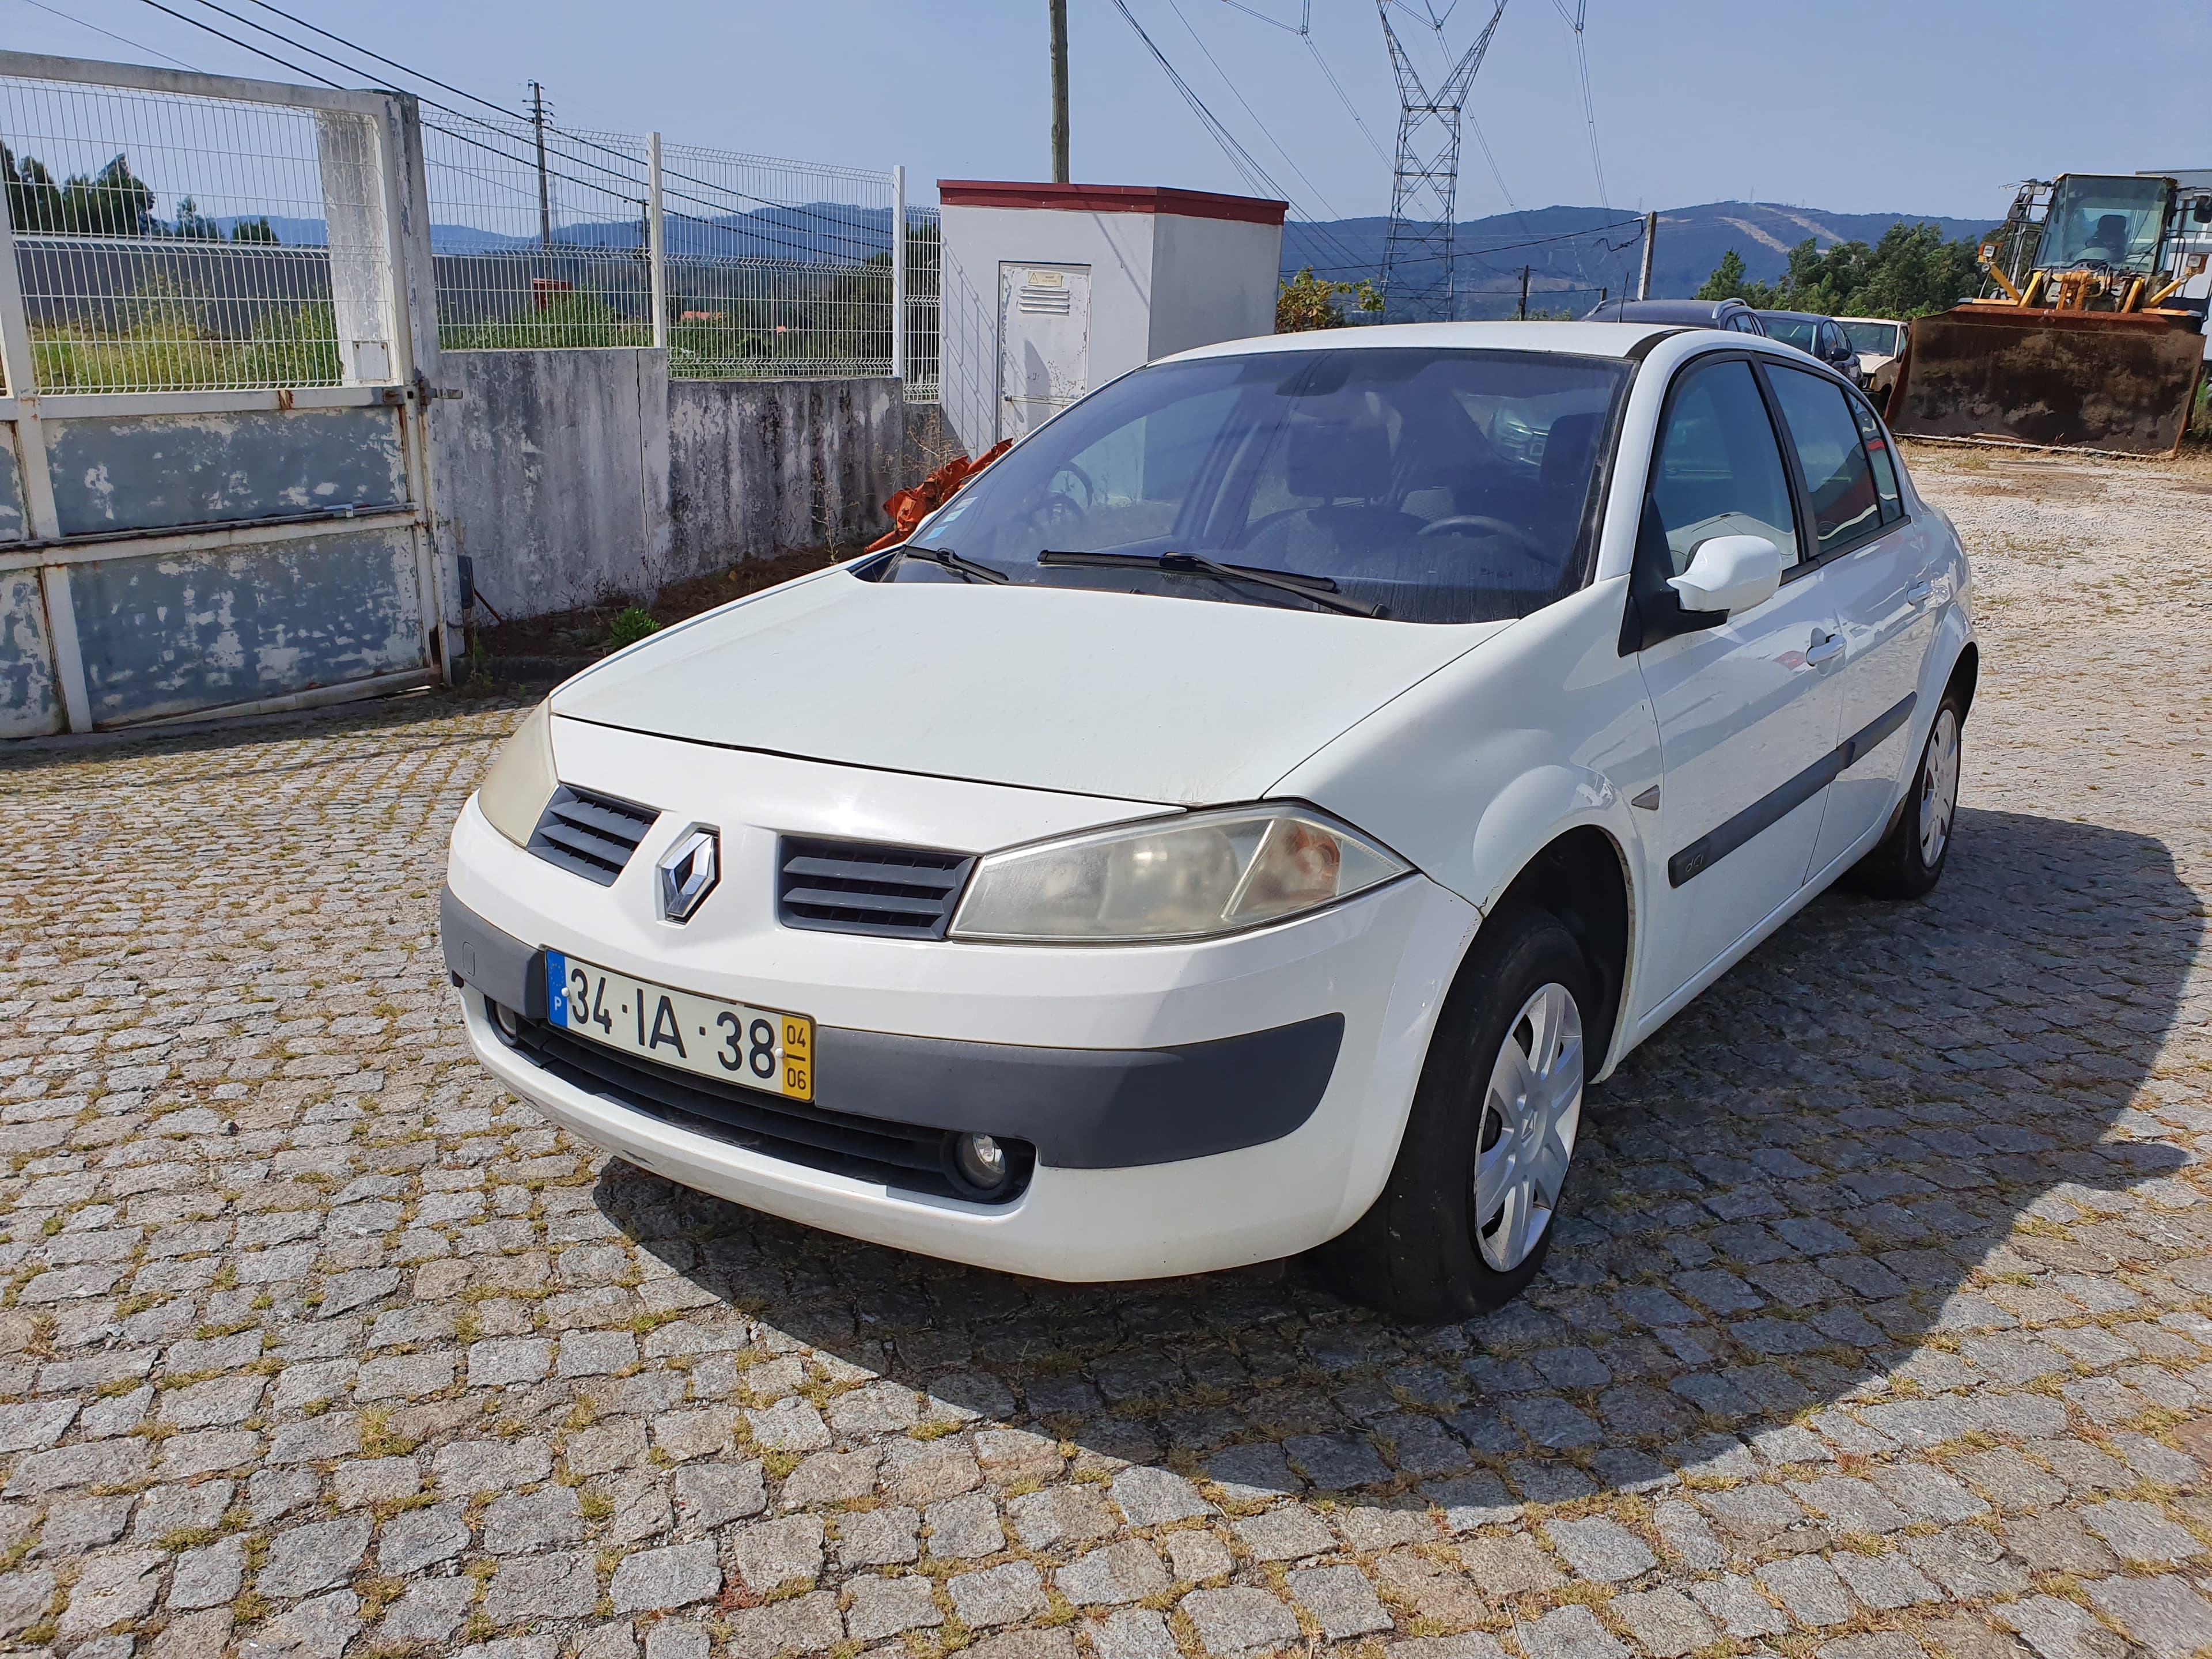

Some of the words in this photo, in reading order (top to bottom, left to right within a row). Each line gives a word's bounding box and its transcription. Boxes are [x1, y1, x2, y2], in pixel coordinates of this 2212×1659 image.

[554, 995, 562, 1011] P
[787, 1024, 806, 1048] 04
[787, 1067, 806, 1090] 06
